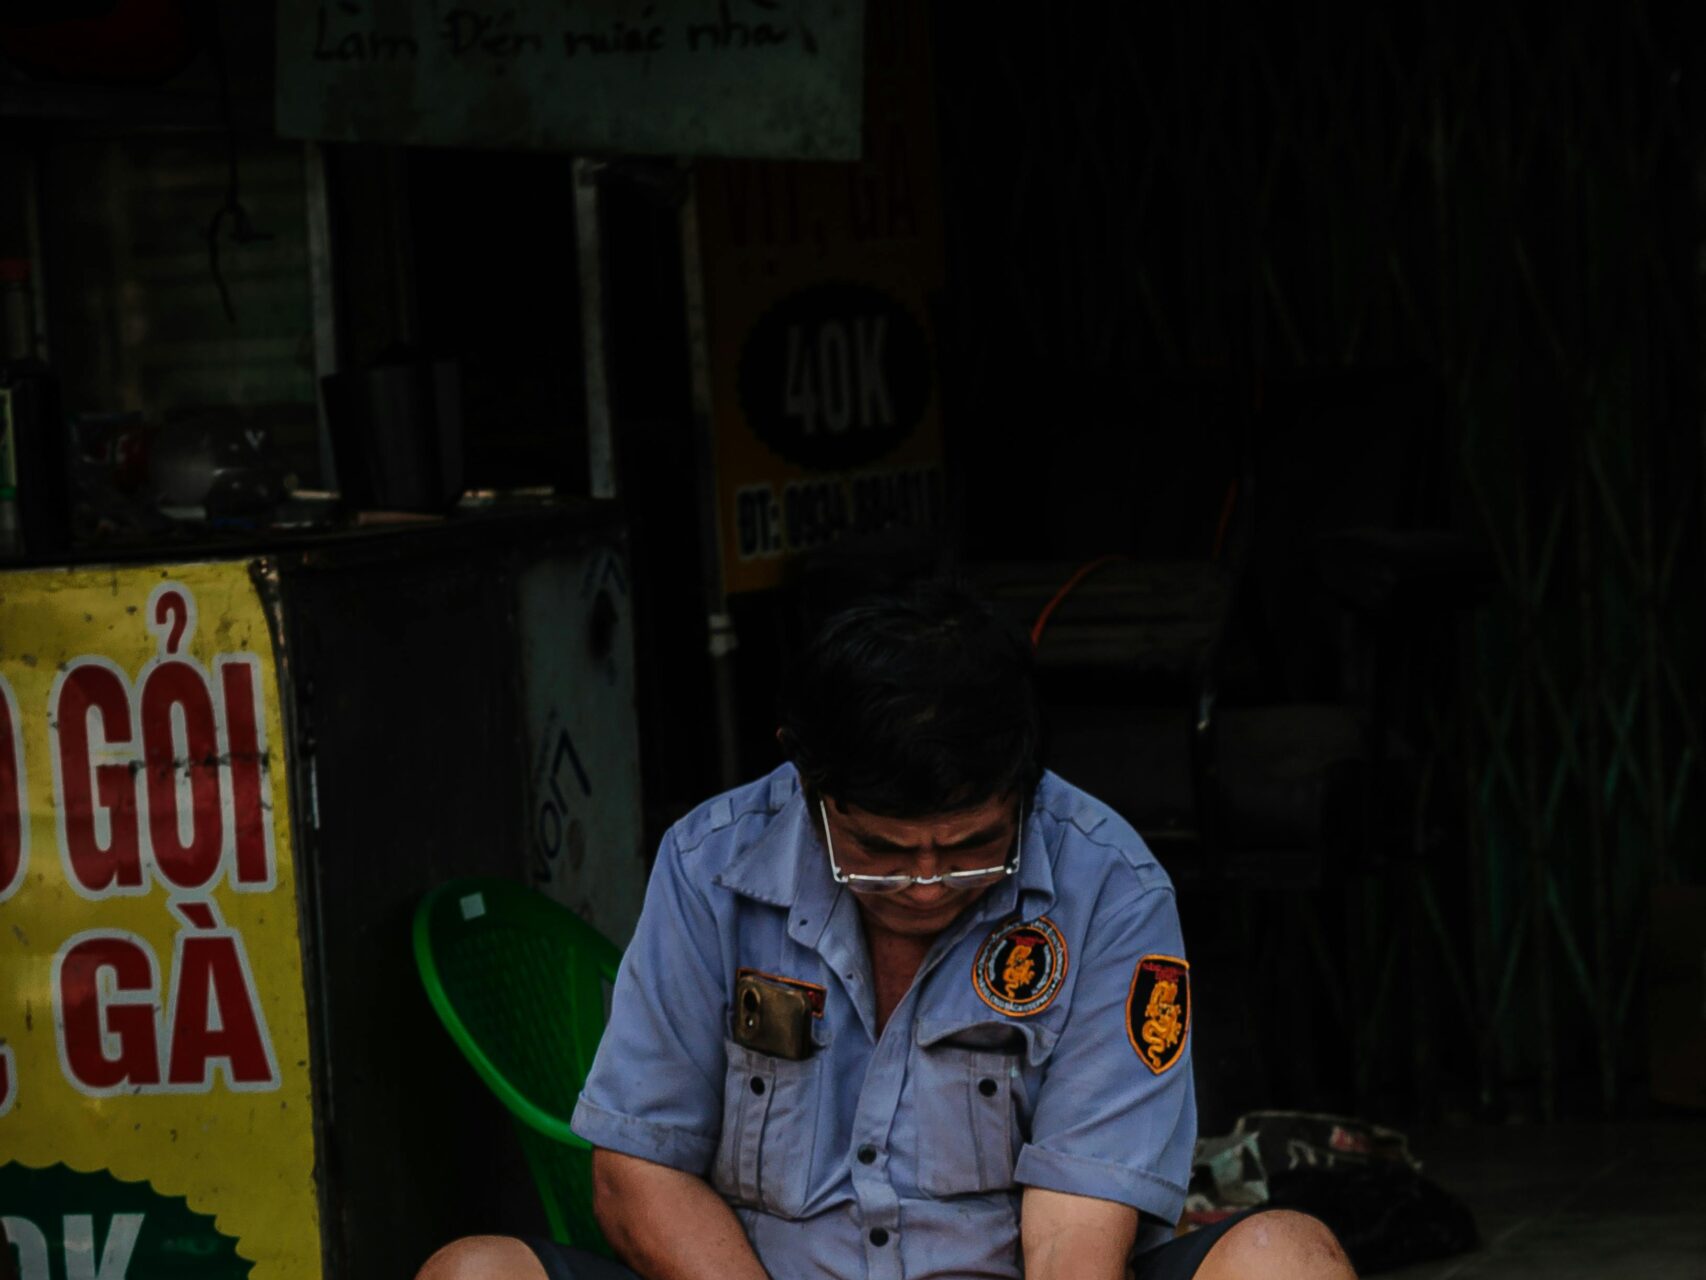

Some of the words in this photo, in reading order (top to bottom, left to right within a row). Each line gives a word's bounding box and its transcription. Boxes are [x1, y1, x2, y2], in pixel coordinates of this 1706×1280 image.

[784, 314, 897, 438] 40K
[57, 590, 268, 892] GỎI
[60, 902, 273, 1089] GÀ
